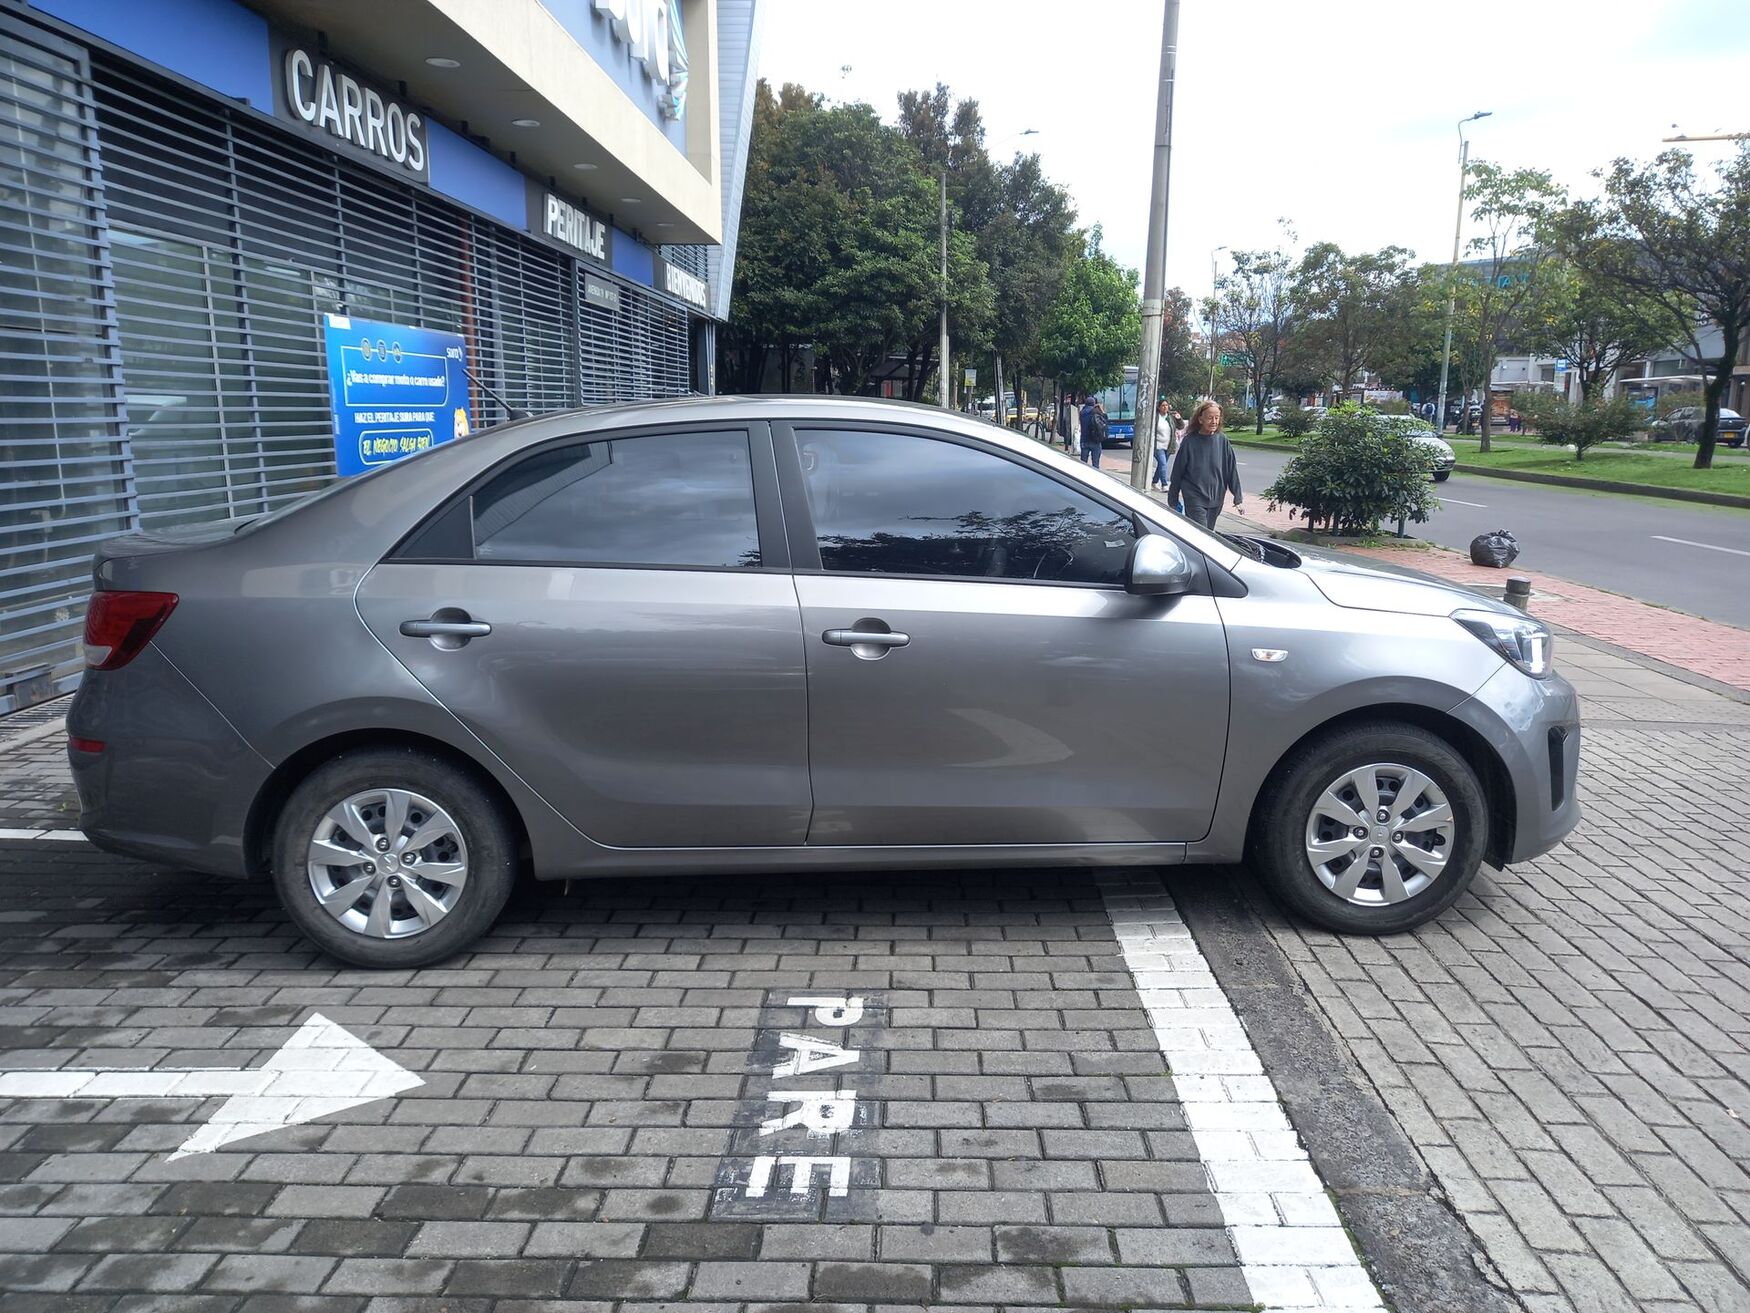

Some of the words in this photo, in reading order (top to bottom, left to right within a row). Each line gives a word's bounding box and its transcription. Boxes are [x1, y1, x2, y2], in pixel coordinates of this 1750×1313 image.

[286, 49, 425, 172] CARROS
[543, 192, 606, 261] PERITAJE
[745, 997, 864, 1197] PARE
